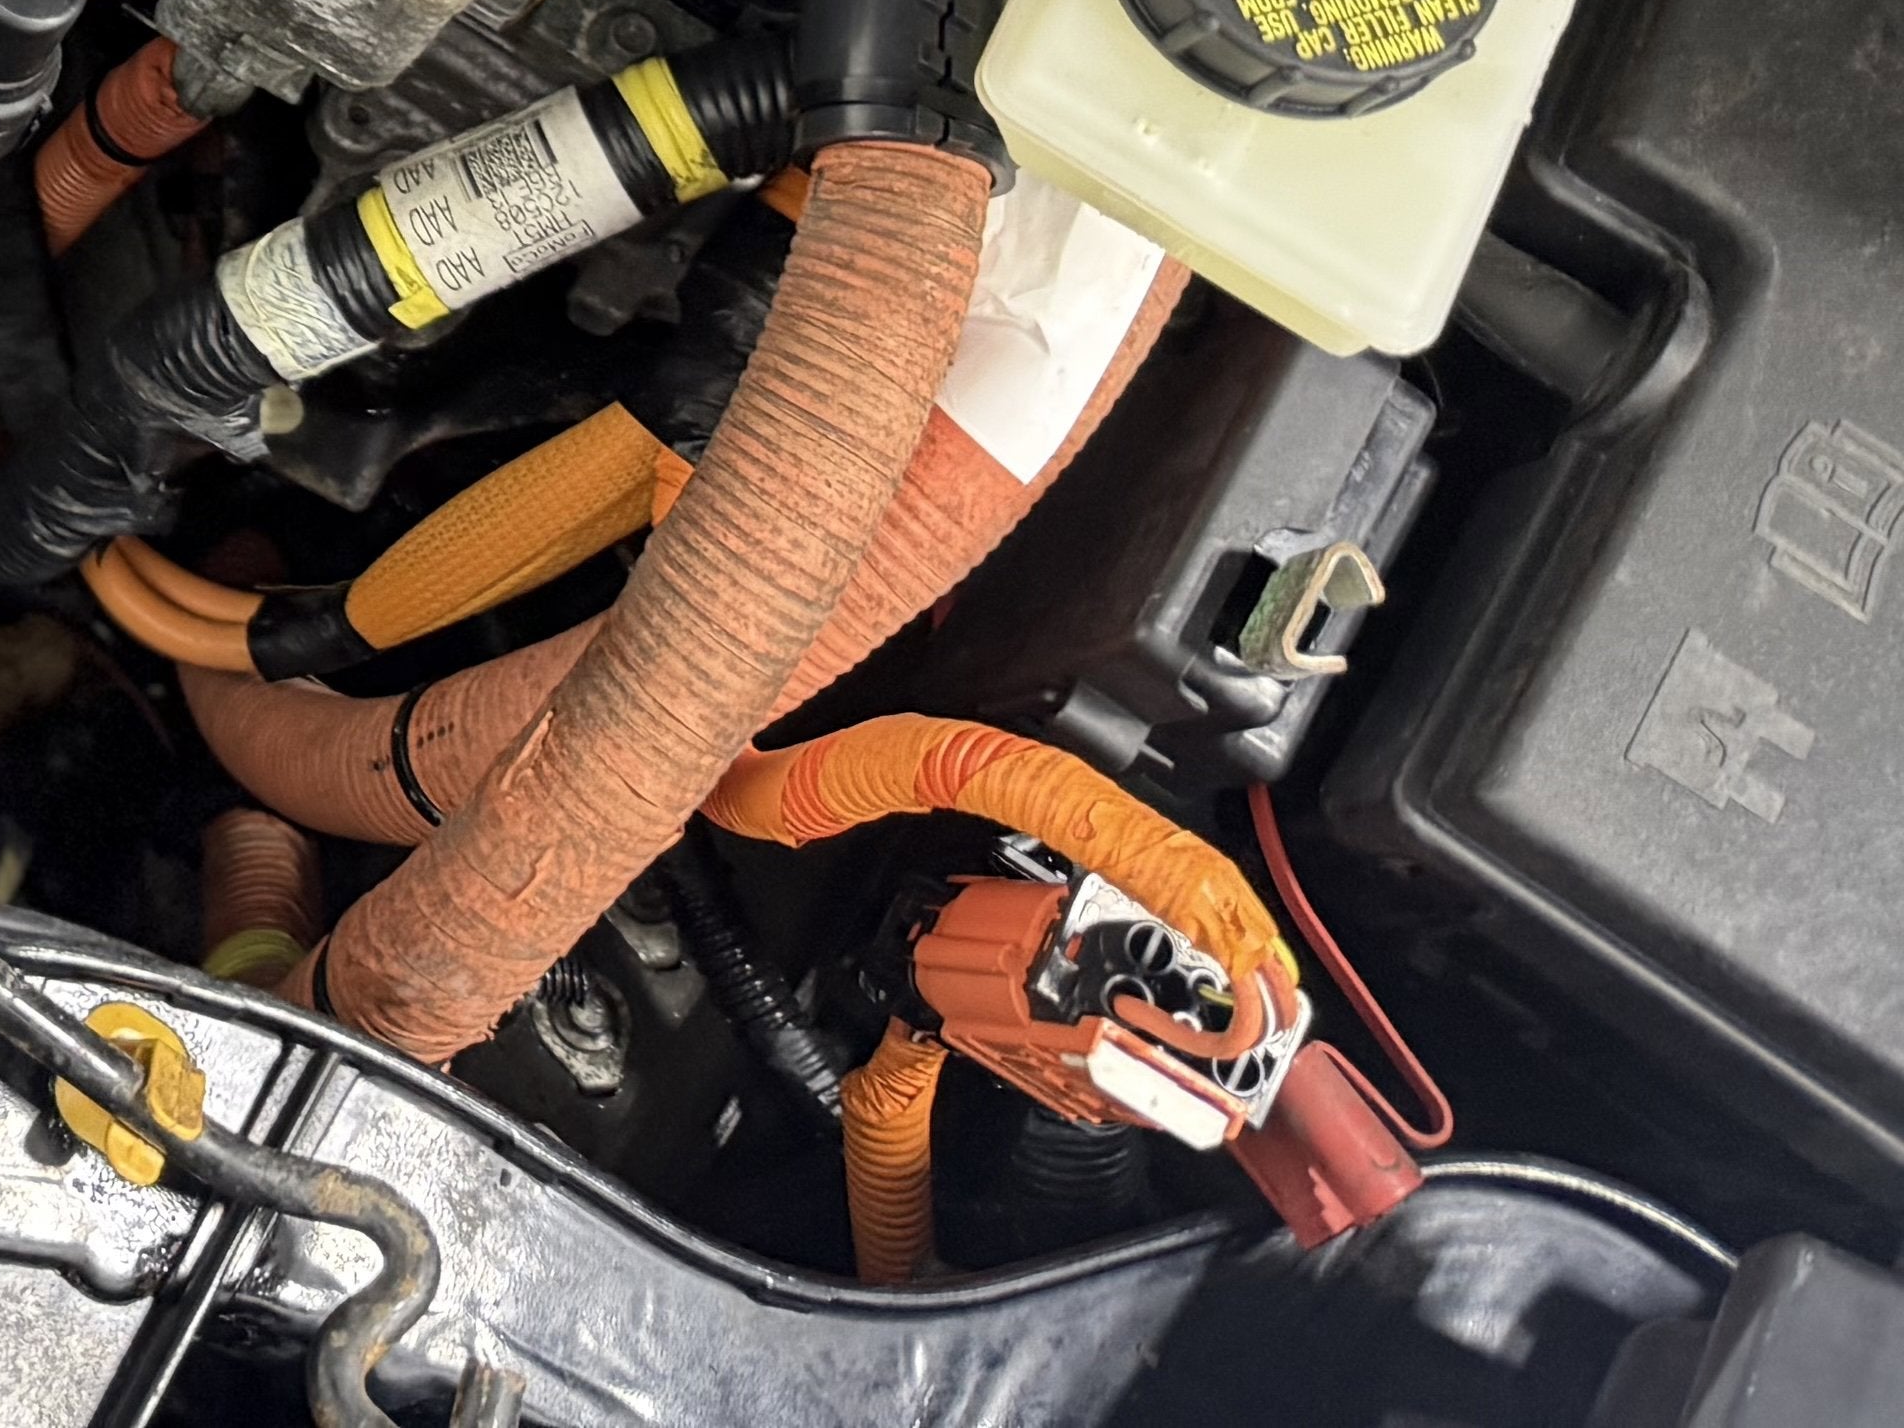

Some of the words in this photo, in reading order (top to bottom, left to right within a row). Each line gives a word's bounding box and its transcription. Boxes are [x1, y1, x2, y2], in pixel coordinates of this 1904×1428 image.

[1253, 8, 1300, 43] USE
[1291, 26, 1337, 60] CAP
[1338, 5, 1412, 46] FILLER
[1342, 25, 1445, 72] WARNING:
[394, 158, 435, 194] AAD
[409, 195, 457, 247] AAD
[436, 247, 485, 291] AAD
